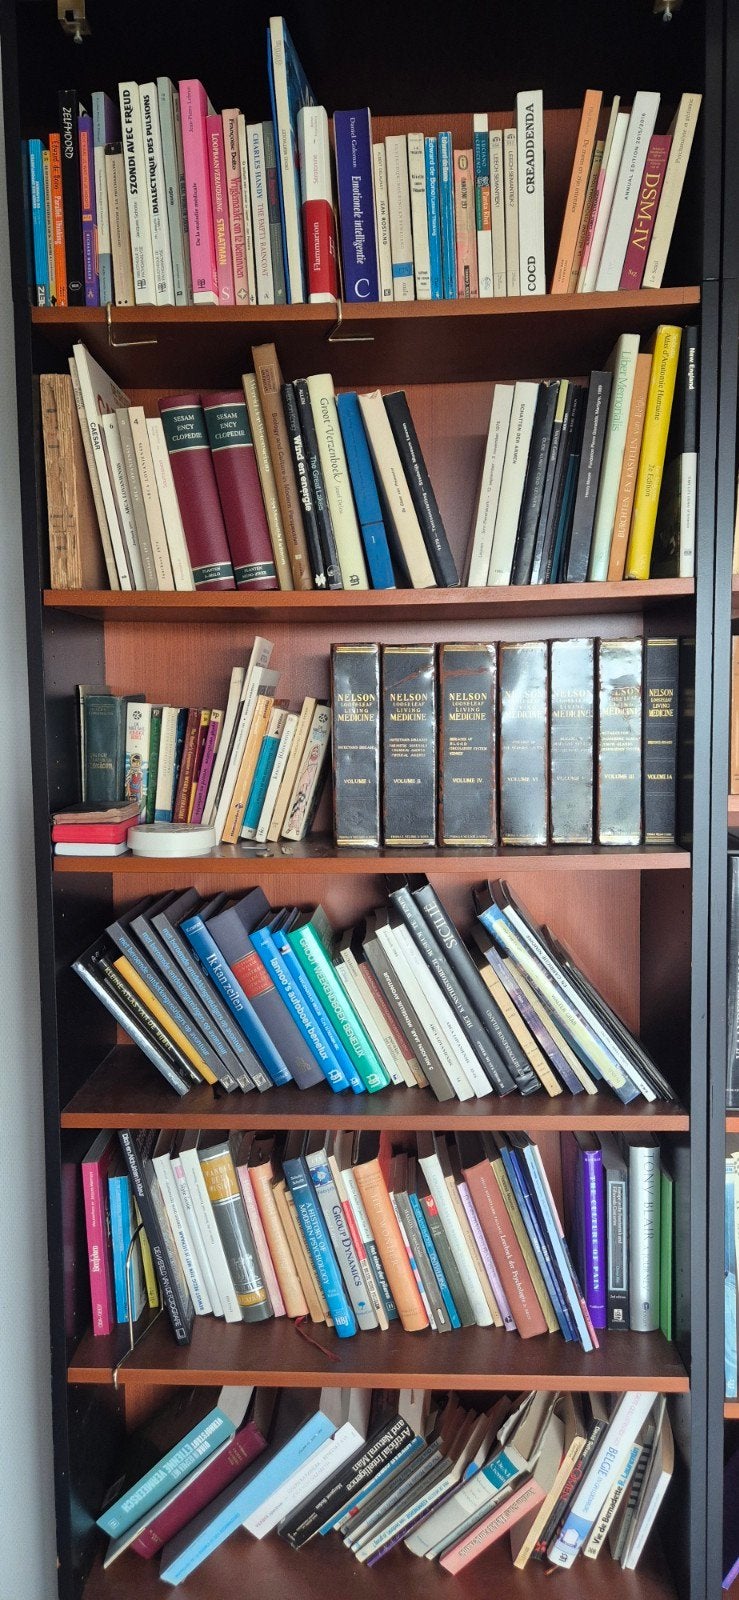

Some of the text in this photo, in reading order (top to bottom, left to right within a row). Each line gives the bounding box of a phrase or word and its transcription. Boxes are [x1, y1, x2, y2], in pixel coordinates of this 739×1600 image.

[62, 107, 74, 159] ZELFMOORD
[122, 89, 133, 124] FREUD
[143, 94, 152, 136] PULSIONS
[130, 158, 138, 195] SZONDI
[147, 156, 160, 214] DIALECTIQUE
[525, 103, 535, 195] CREADDENDA
[623, 112, 647, 201] ANNUAL EDITION 2015/2016
[229, 177, 247, 278] Vrijgemaakt beminnen
[252, 133, 261, 170] CHARLES
[260, 242, 269, 276] RAINCOAT
[351, 175, 364, 219] Emotionele
[631, 172, 661, 250] DSM-IV
[216, 218, 226, 266] STRAATMAN
[353, 219, 368, 265] intelligentie
[528, 255, 536, 291] COCD
[612, 351, 632, 432] Liber Memorialis
[654, 333, 671, 421] Atlas d'Anatomie Humaine
[89, 422, 101, 451] CAESAR
[272, 413, 280, 435] Biology
[319, 397, 340, 482] Groot Verzenboek
[293, 435, 312, 512] Wind en energie
[315, 489, 323, 511] Lakes
[617, 438, 640, 538] BURCHTEN EN KASTELEN
[645, 472, 653, 496] Edition
[179, 794, 187, 820] LITERATURE
[397, 895, 474, 1030] HET KUNSTHISTORISCH MUSEUM WENEN
[424, 903, 458, 950] SICILIË
[104, 966, 173, 1051] KLEINE ATLAS BIJBEL
[126, 946, 150, 974] beroemde
[188, 1032, 209, 1056] avontuur
[149, 942, 171, 970] beroemde
[206, 1031, 228, 1056] avontuur
[168, 938, 190, 966] beroemde
[224, 1028, 245, 1054] avontuur
[205, 953, 244, 1012] Ik kan zeilen
[270, 957, 329, 1060] lannoo's autoboek benelux
[299, 938, 367, 1059] GROOT WEEKENDBOEK BENELUX
[383, 971, 432, 1067] MILJOEN MENSELIJK AVONTUUR
[307, 1207, 323, 1238] HISTORY
[319, 1242, 326, 1252] OF
[643, 1154, 655, 1240] TONY BLAIR
[299, 1204, 313, 1236] MODERN
[308, 1236, 330, 1285] PSYCHOLOGY
[332, 1205, 362, 1287] GROUP DYNAMICS
[500, 1234, 527, 1305] Leerboek Psychologie
[592, 1249, 598, 1259] OF
[155, 1255, 182, 1332] WERELD FOTOGRAFIE
[194, 1291, 205, 1311] BEWUST
[121, 1417, 224, 1514] VERHOFSTADT ETIENNE VERMEERSCH
[196, 1441, 211, 1455] DIRK
[346, 1426, 412, 1491] Artificial Intelligence
[351, 1419, 405, 1472] and Natural Man
[590, 1426, 600, 1441] David
[600, 1523, 606, 1532] de
[604, 1485, 623, 1523] Bernadette
[621, 1447, 640, 1478] Laurentin
